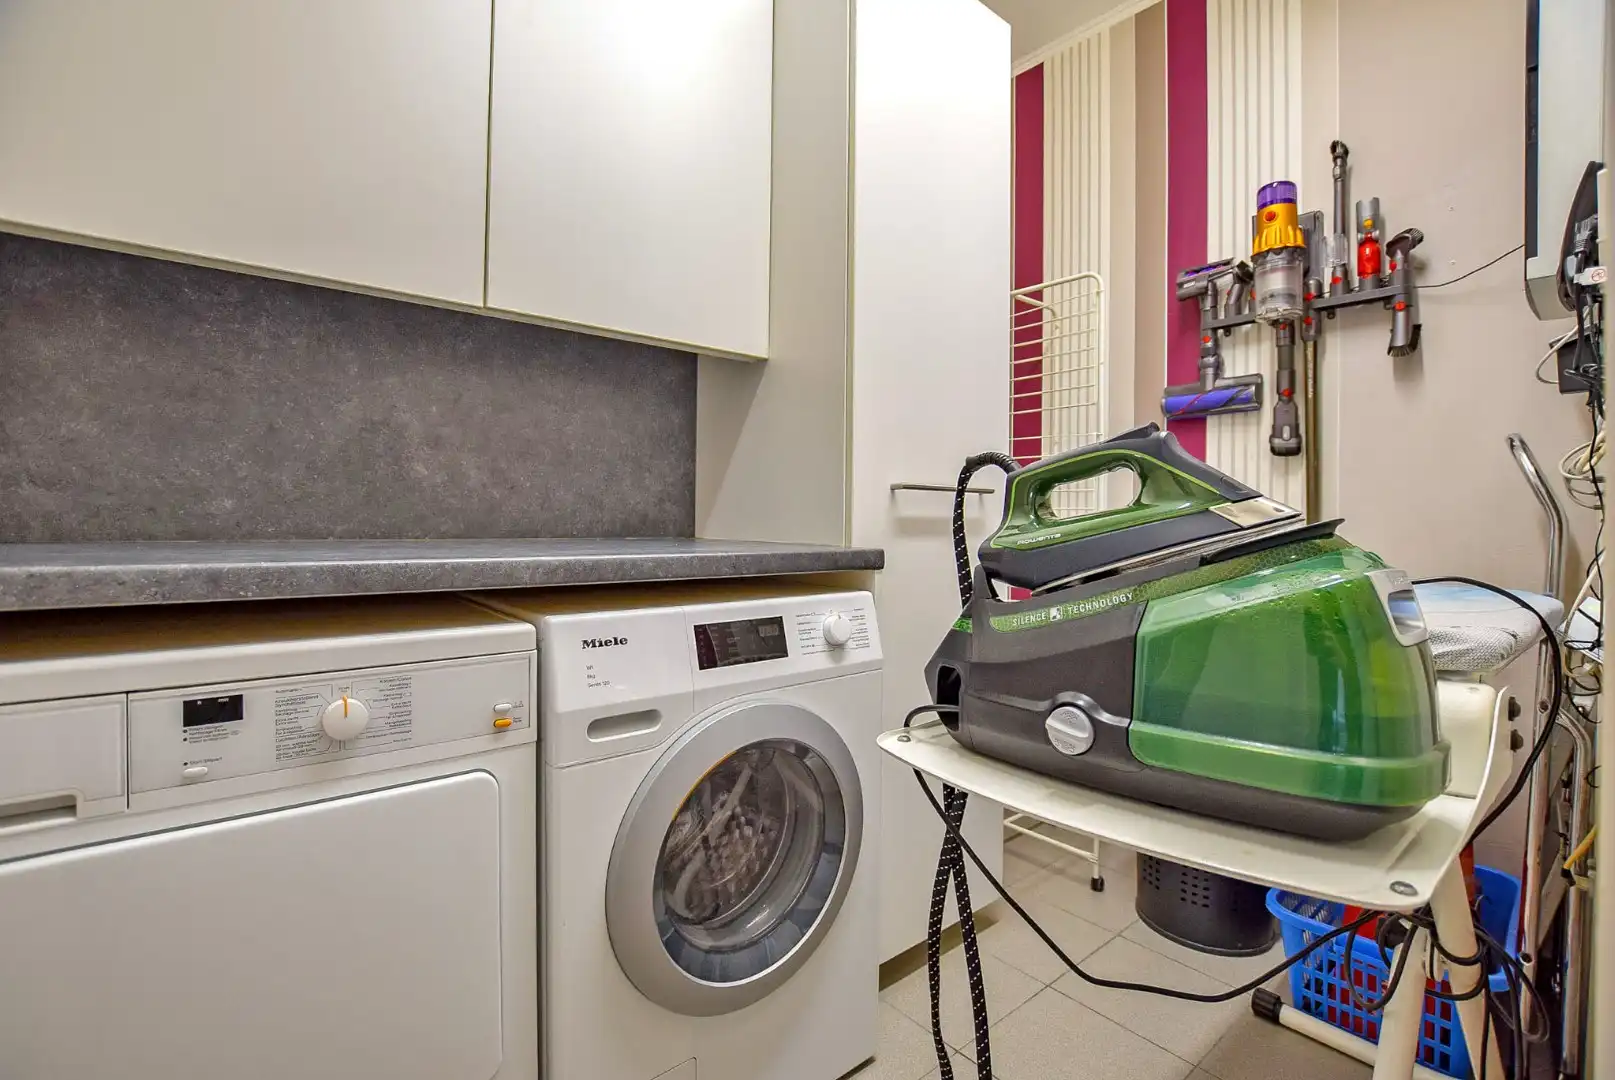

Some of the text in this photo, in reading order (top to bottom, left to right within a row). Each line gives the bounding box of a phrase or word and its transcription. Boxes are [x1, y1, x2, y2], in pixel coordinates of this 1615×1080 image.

[1012, 592, 1133, 627] SILENCE TECHNOLOGY
[581, 636, 629, 650] Miele
